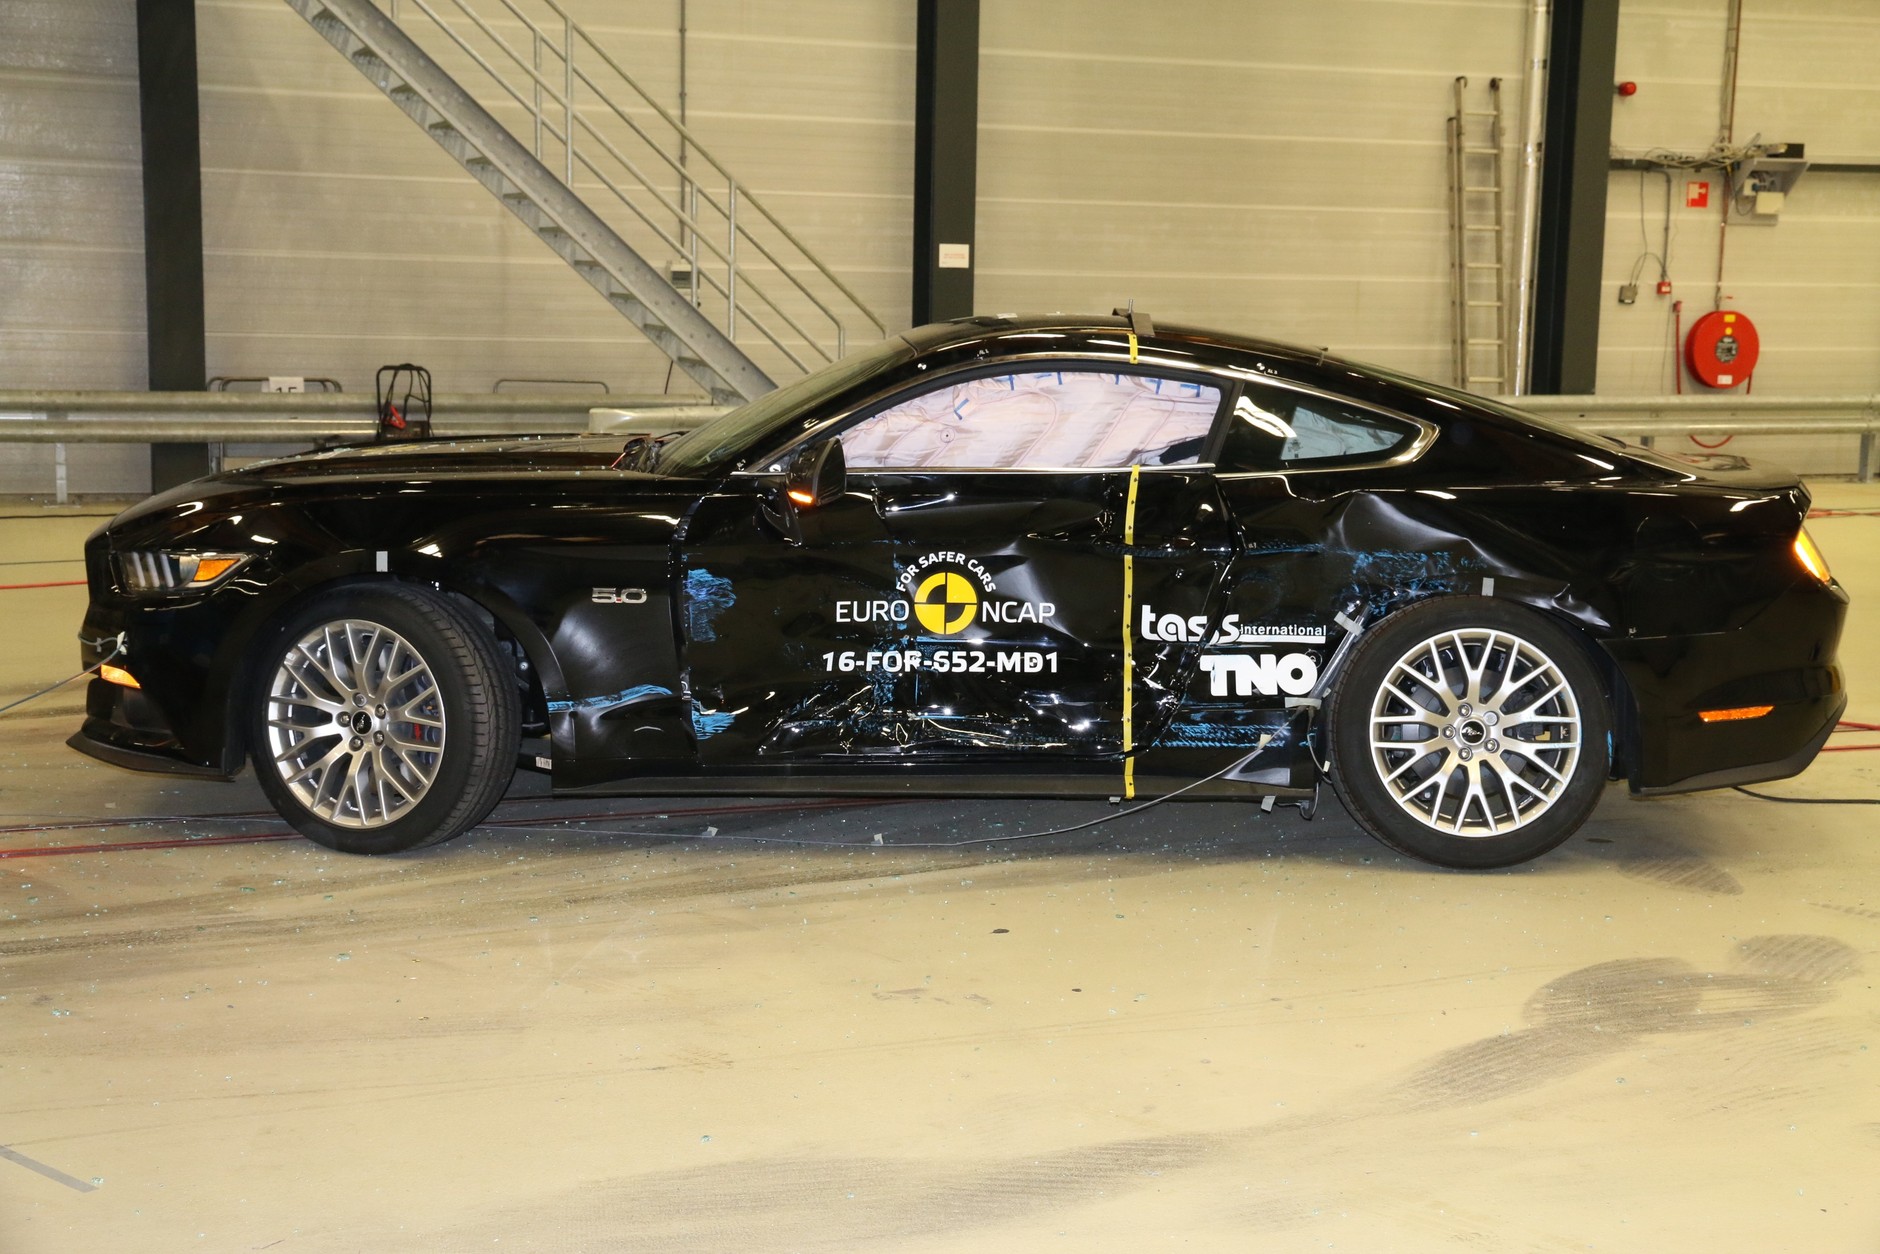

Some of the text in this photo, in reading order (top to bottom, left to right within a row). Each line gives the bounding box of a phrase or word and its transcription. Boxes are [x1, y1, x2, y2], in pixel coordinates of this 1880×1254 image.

[896, 551, 996, 593] FOR SAFER CARS
[591, 587, 648, 604] 5.0
[835, 600, 1056, 623] EURO NCAP
[1240, 625, 1326, 636] international
[822, 650, 1058, 673] 16-FOR-S52-MD1
[1199, 653, 1318, 696] TNO
